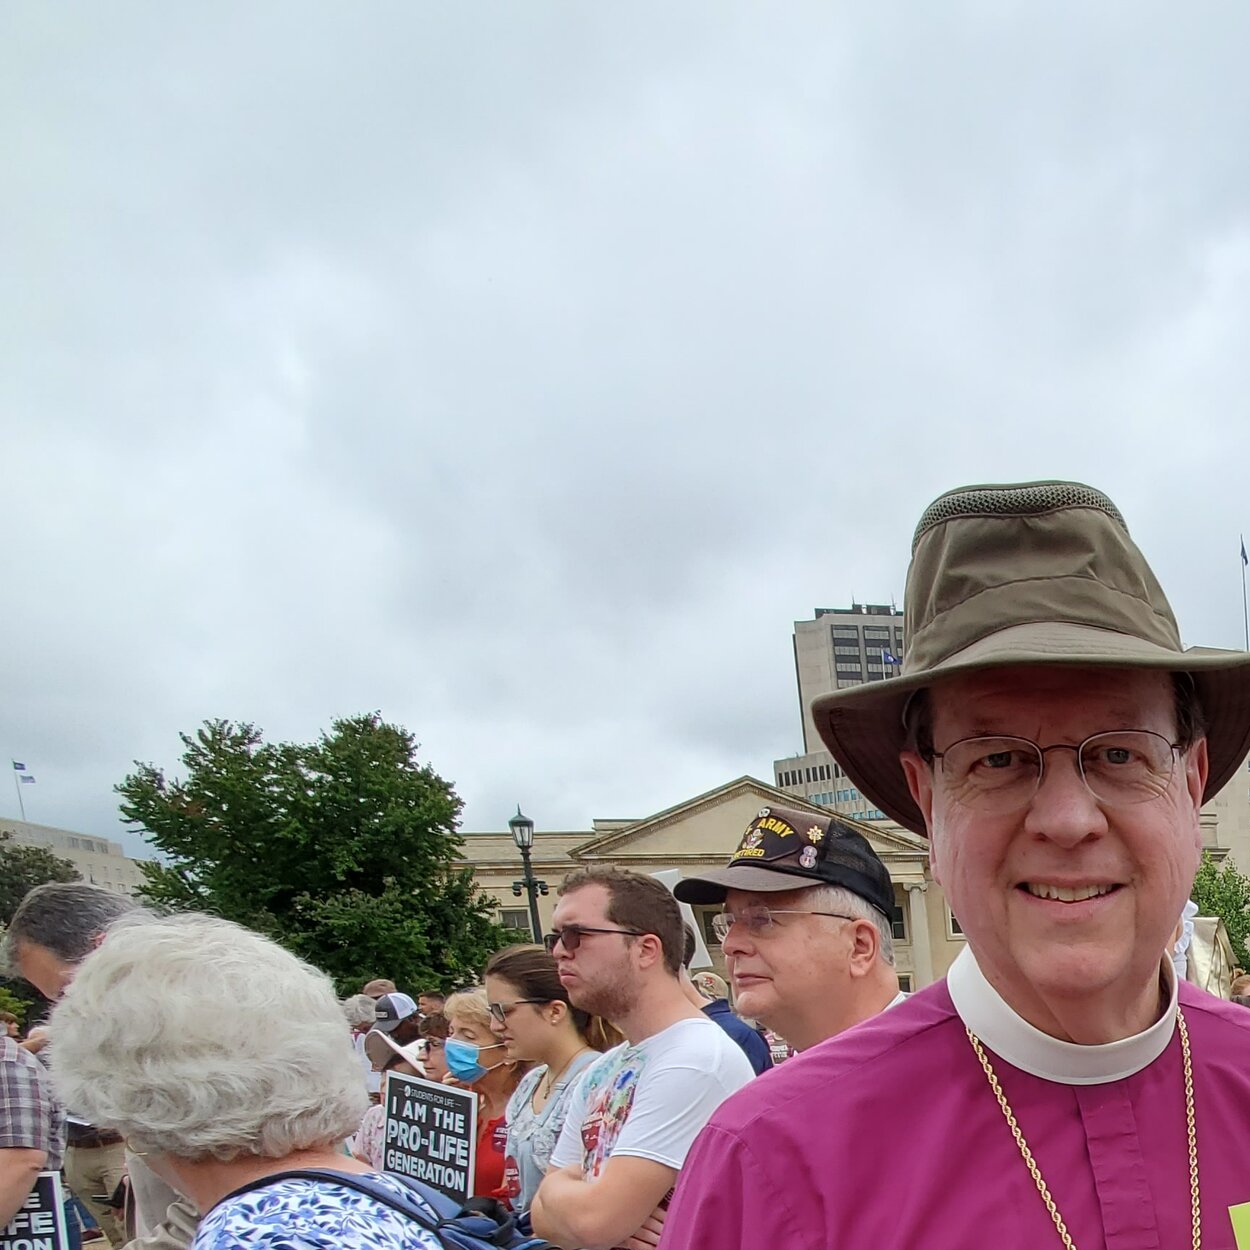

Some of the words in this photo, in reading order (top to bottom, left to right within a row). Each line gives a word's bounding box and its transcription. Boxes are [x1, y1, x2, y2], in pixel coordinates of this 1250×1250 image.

[757, 818, 794, 838] ARMY
[391, 1096, 398, 1115] I
[401, 1099, 427, 1123] AM
[432, 1106, 465, 1134] THE
[444, 1097, 455, 1108] LIFE
[386, 1117, 469, 1167] PRO-LIFE
[386, 1149, 466, 1192] GENERATION
